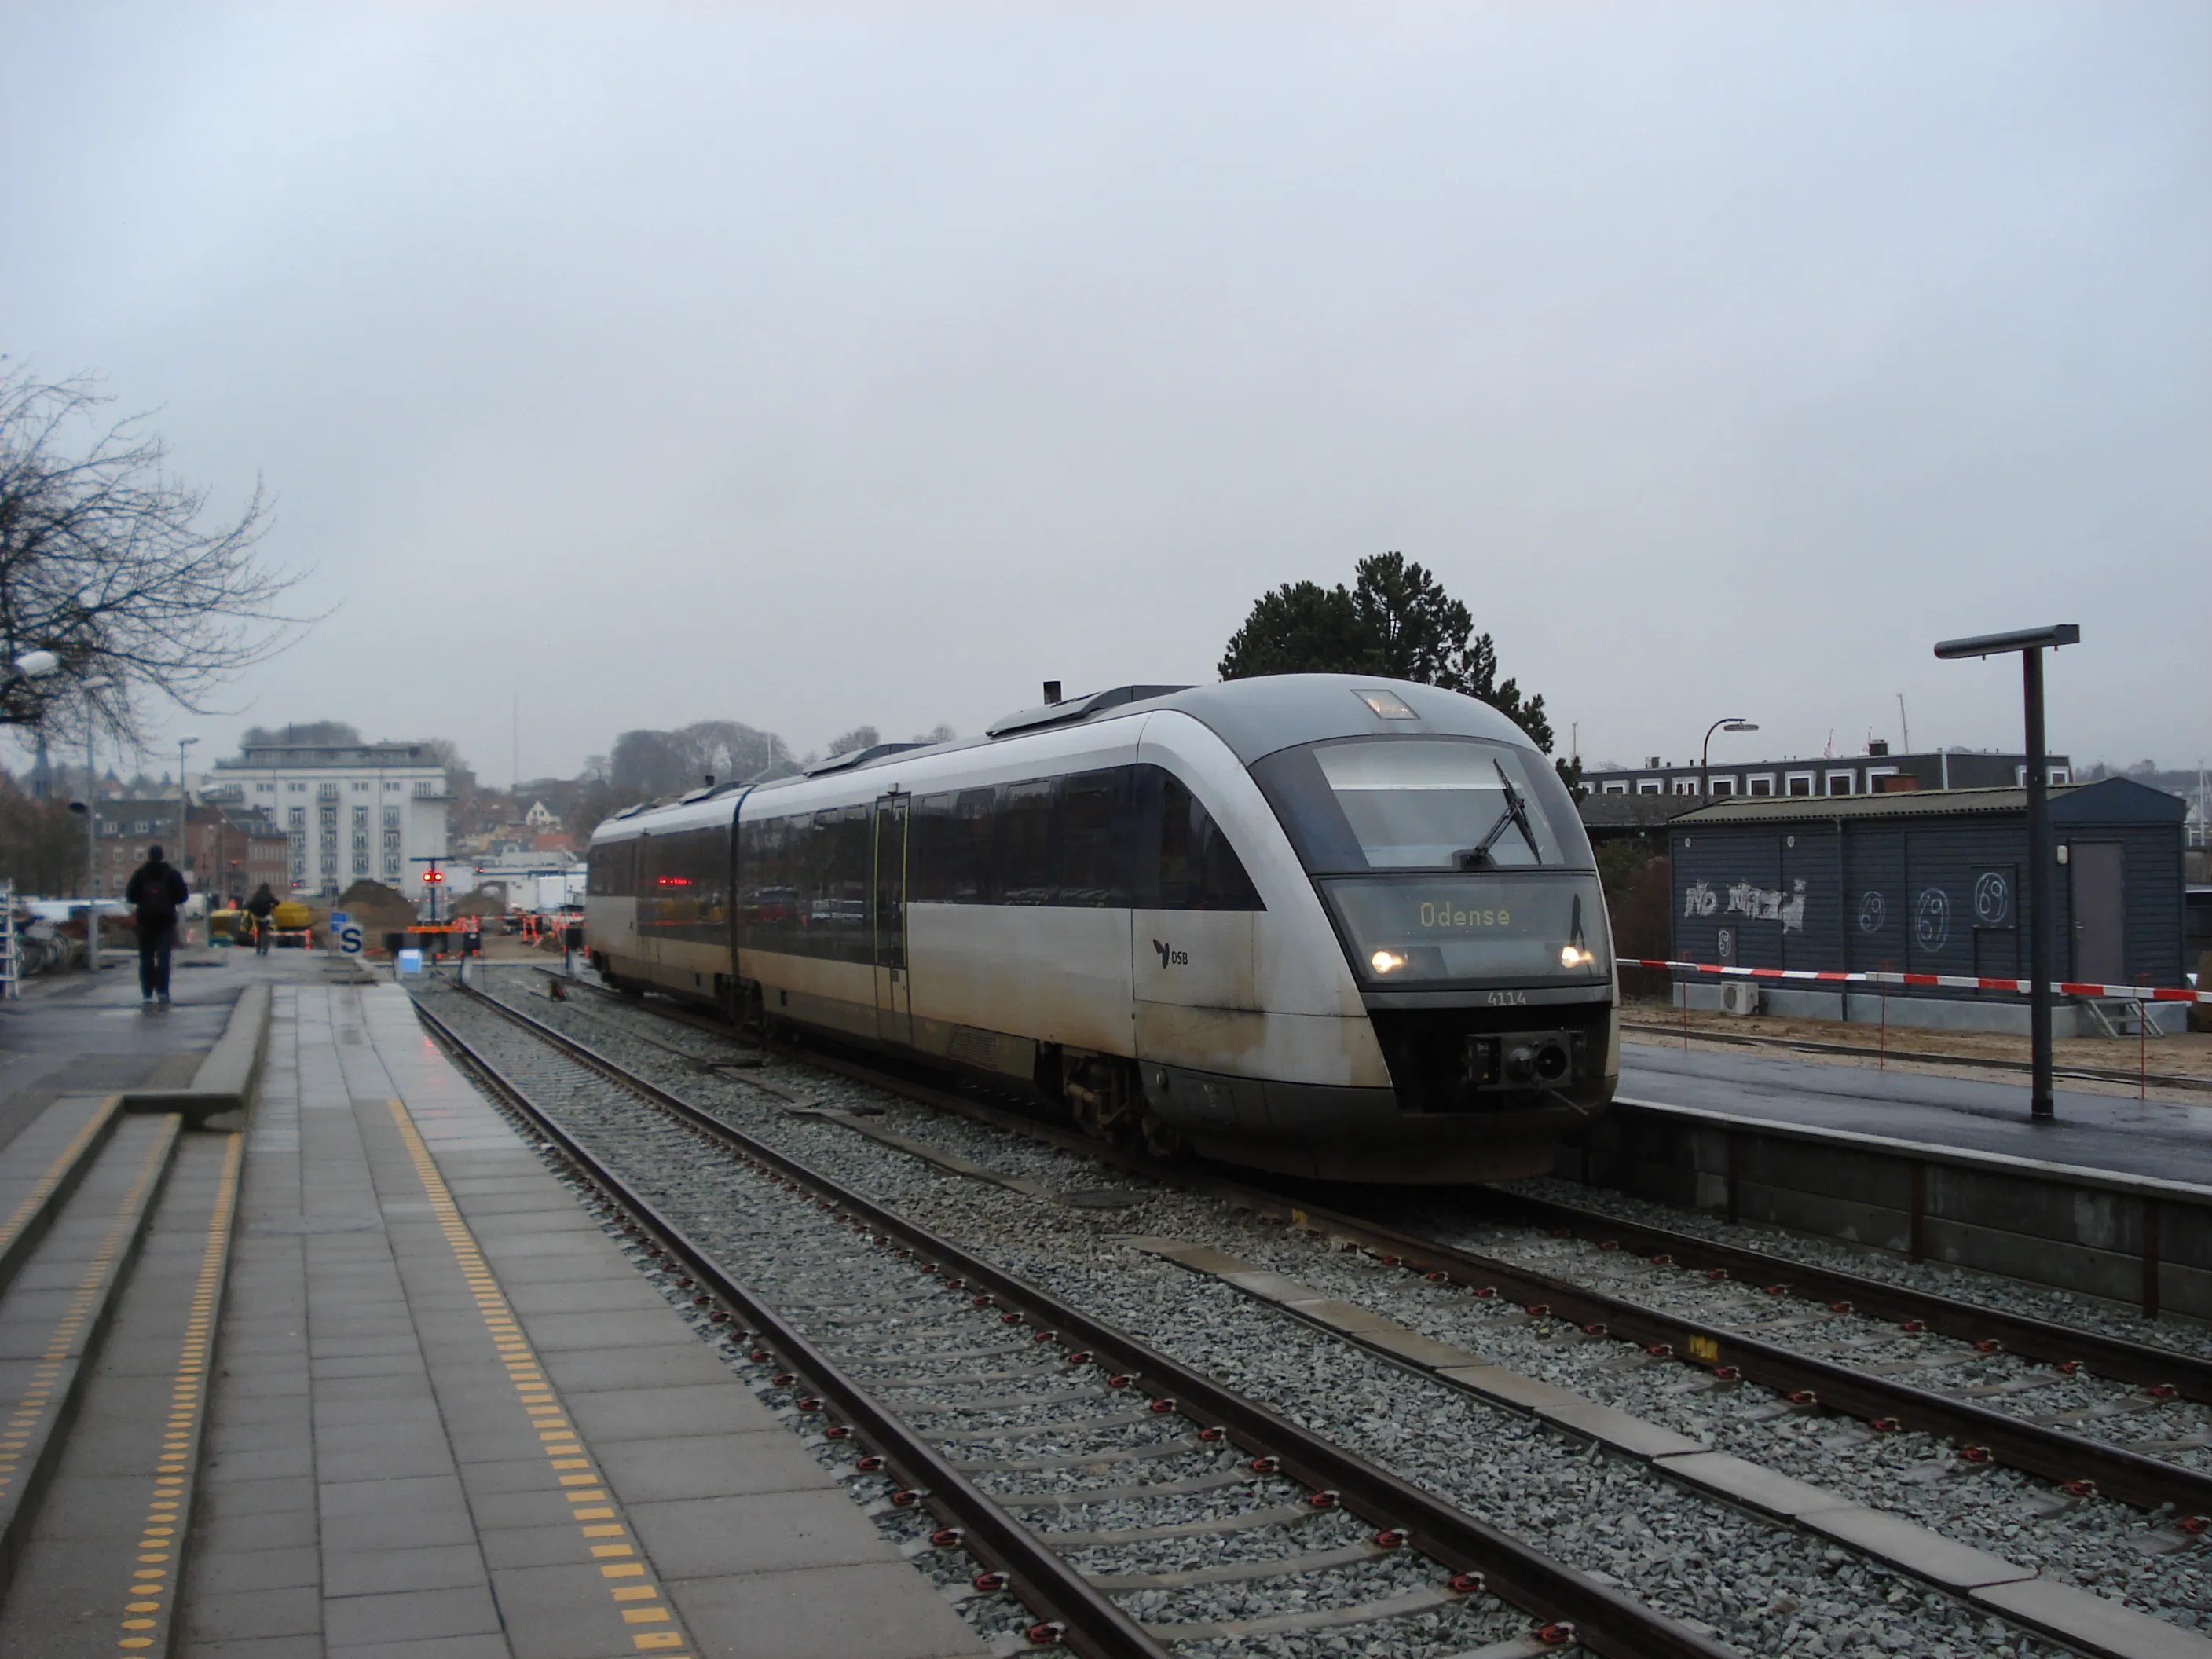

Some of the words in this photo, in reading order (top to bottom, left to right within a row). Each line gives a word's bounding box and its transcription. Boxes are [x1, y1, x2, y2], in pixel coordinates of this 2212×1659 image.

[1420, 902, 1511, 927] Odense
[341, 928, 361, 953] S
[1171, 950, 1188, 965] DSB
[1487, 991, 1528, 1006] 4114
